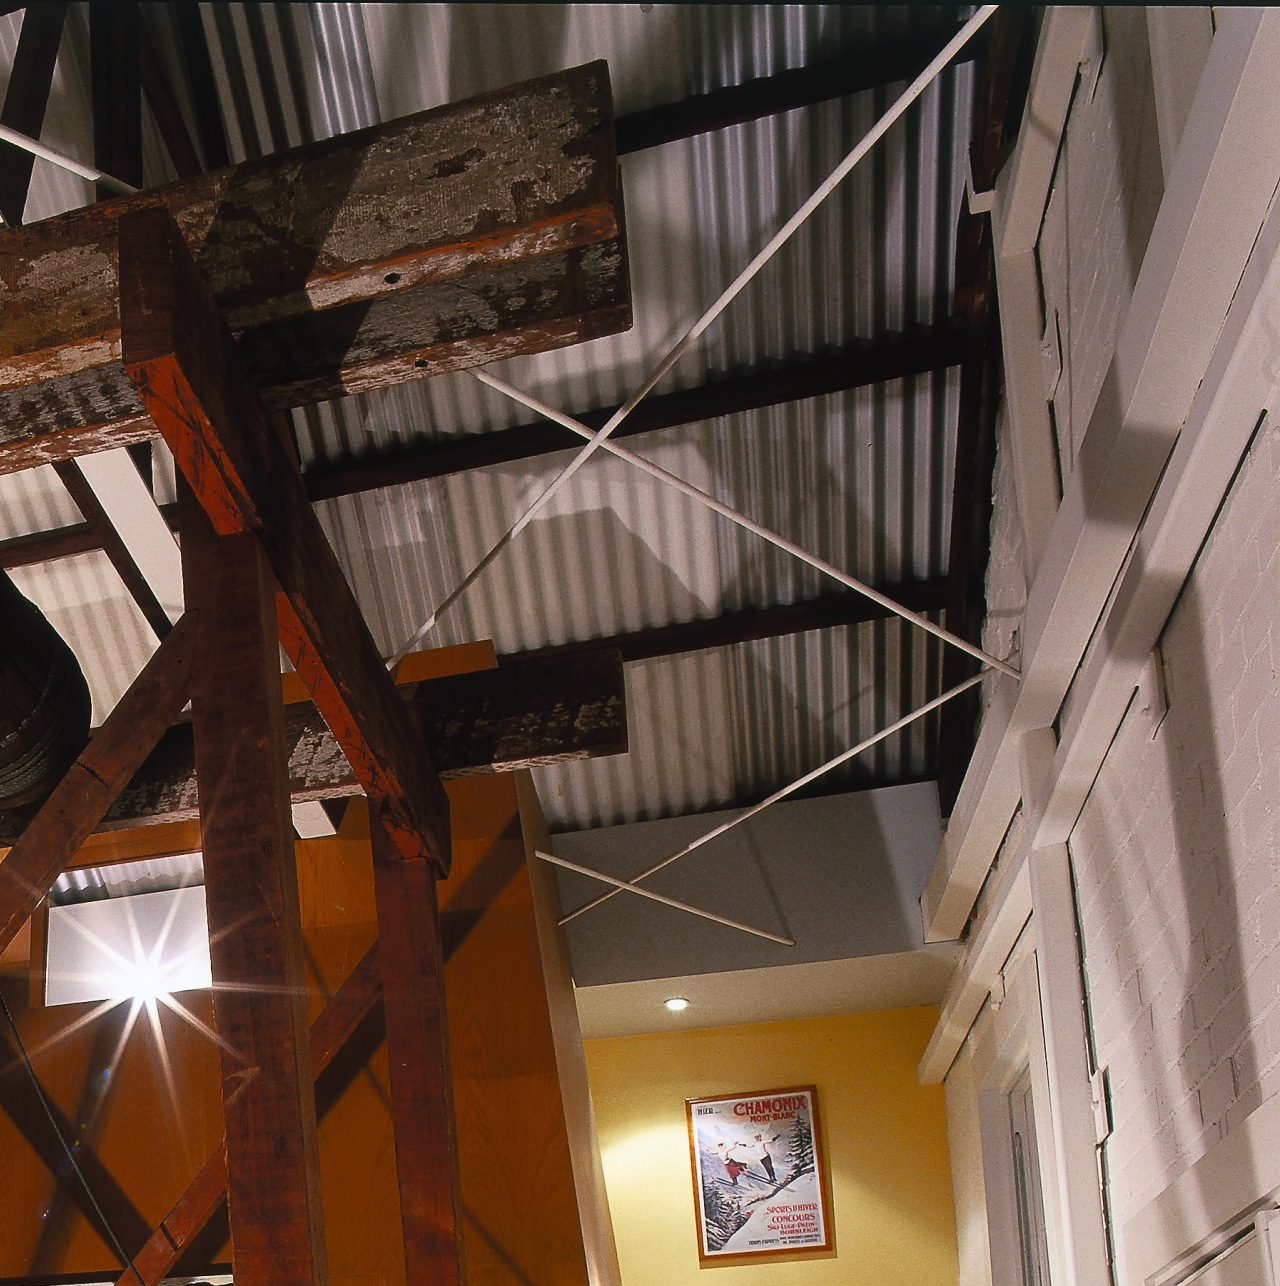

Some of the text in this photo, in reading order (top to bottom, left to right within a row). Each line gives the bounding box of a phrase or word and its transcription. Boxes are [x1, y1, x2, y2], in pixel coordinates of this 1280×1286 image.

[733, 1095, 807, 1116] CHAMONIX
[750, 1111, 796, 1123] MONT-BLANC
[767, 1204, 792, 1213] SPORTS
[772, 1213, 816, 1223] CONCOURS
[780, 1227, 819, 1235] BOBSLEIGH
